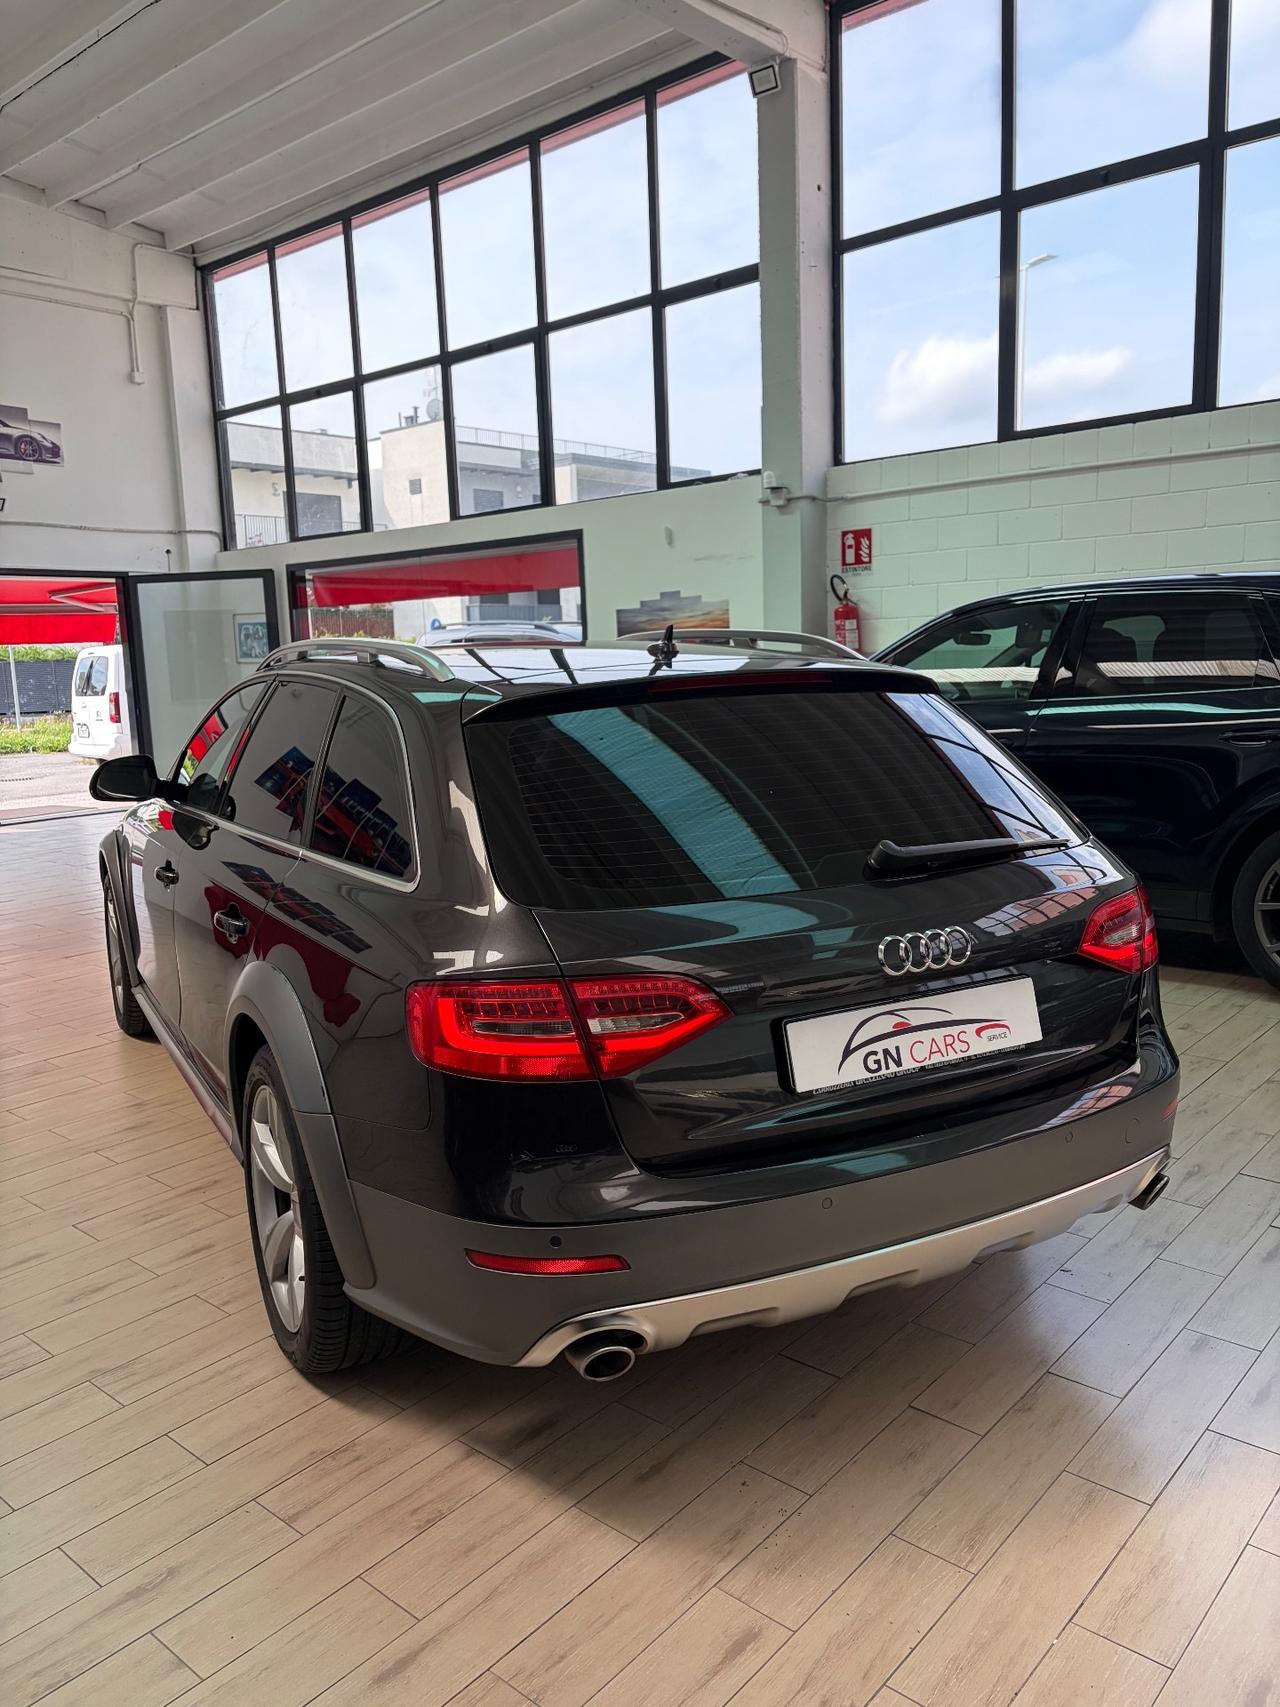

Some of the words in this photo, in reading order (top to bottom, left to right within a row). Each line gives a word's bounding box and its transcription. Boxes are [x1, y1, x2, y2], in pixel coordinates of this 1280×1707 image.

[841, 565, 872, 574] ESTINTORE
[986, 1031, 1009, 1042] SERVICE
[863, 1045, 903, 1075] GN
[909, 1030, 971, 1064] CARS
